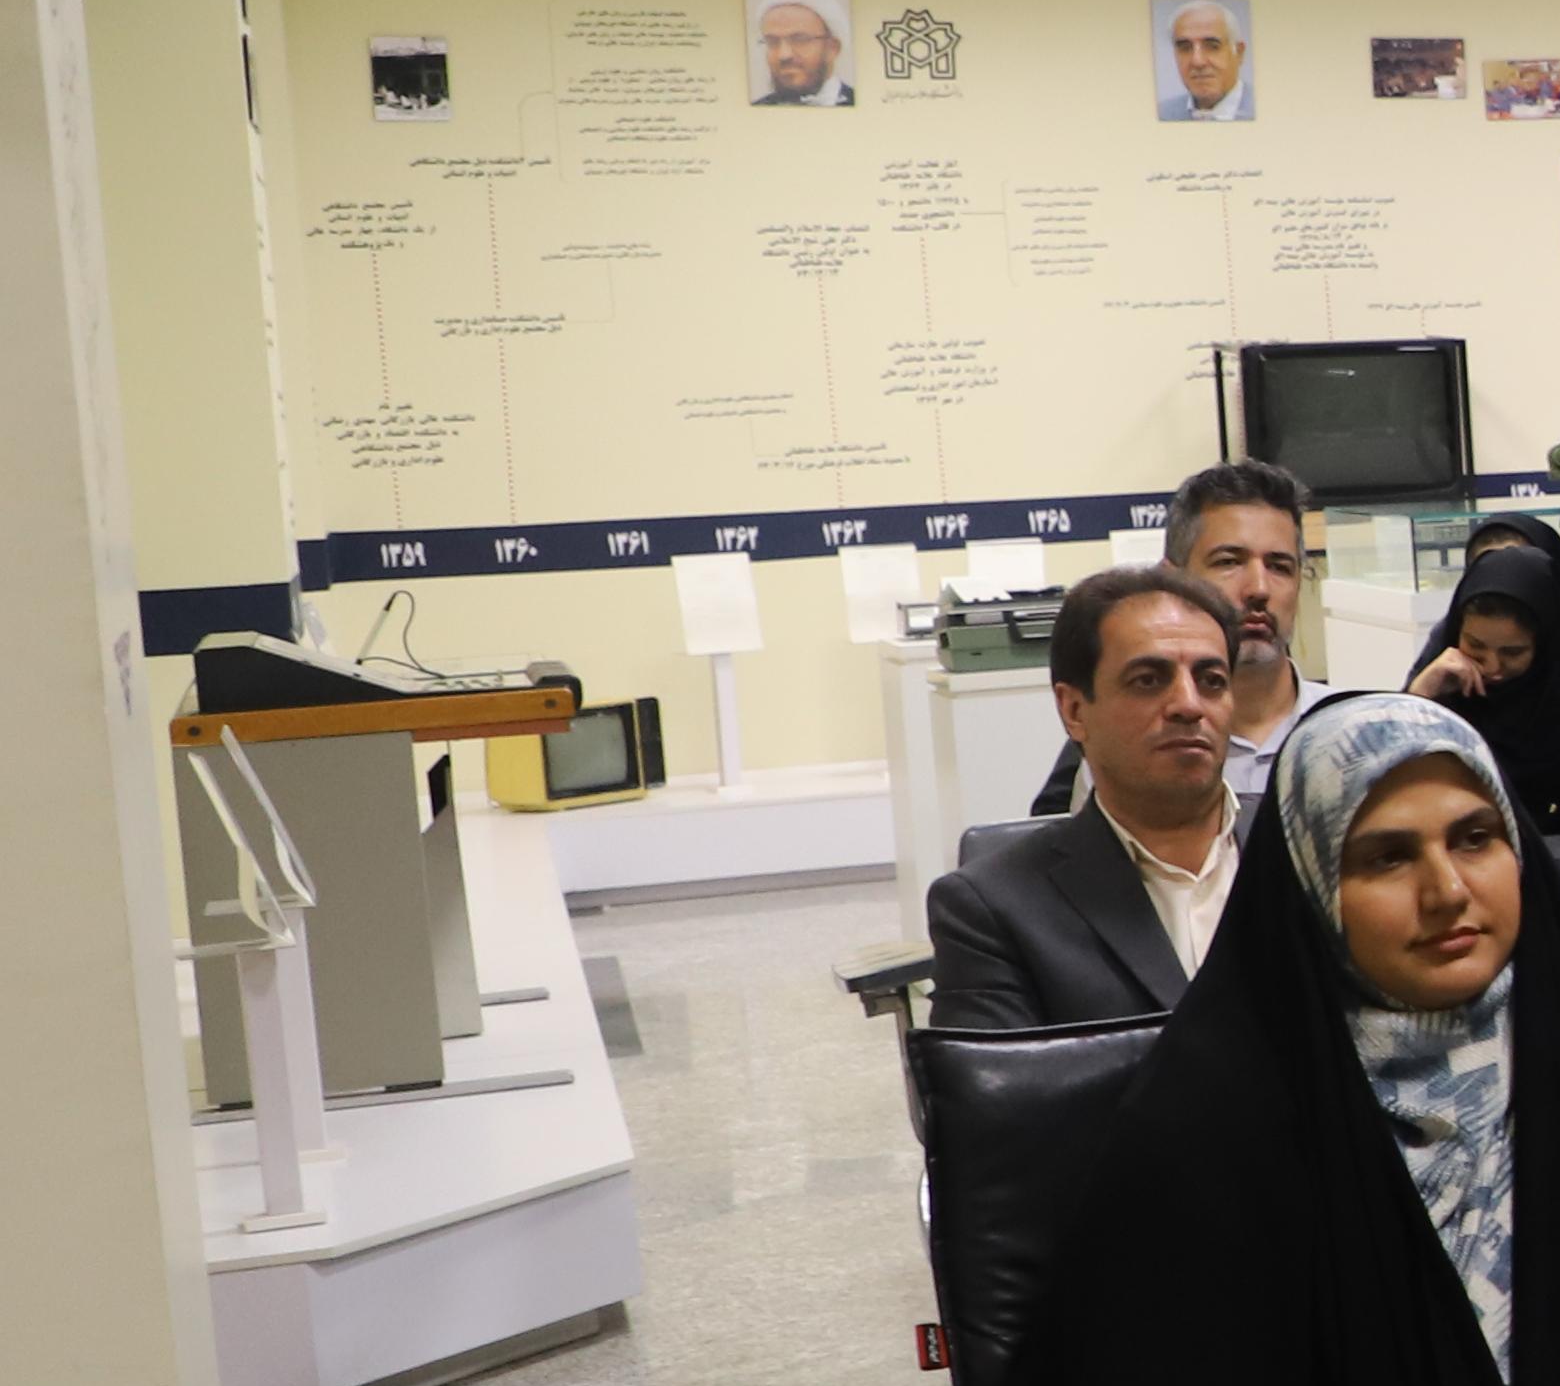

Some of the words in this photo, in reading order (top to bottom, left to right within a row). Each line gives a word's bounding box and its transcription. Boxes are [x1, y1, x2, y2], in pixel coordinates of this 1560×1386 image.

[380, 542, 427, 569] ۱۳۵۹
[495, 537, 538, 564] ۱۳۶۰
[607, 531, 651, 558] ۱۳۶۱
[715, 526, 758, 553] ۱۳۶۲
[822, 520, 868, 547] ۱۳۶۳
[924, 514, 970, 541] ۱۳۶۴
[1027, 509, 1072, 535] ۱۳۶۵
